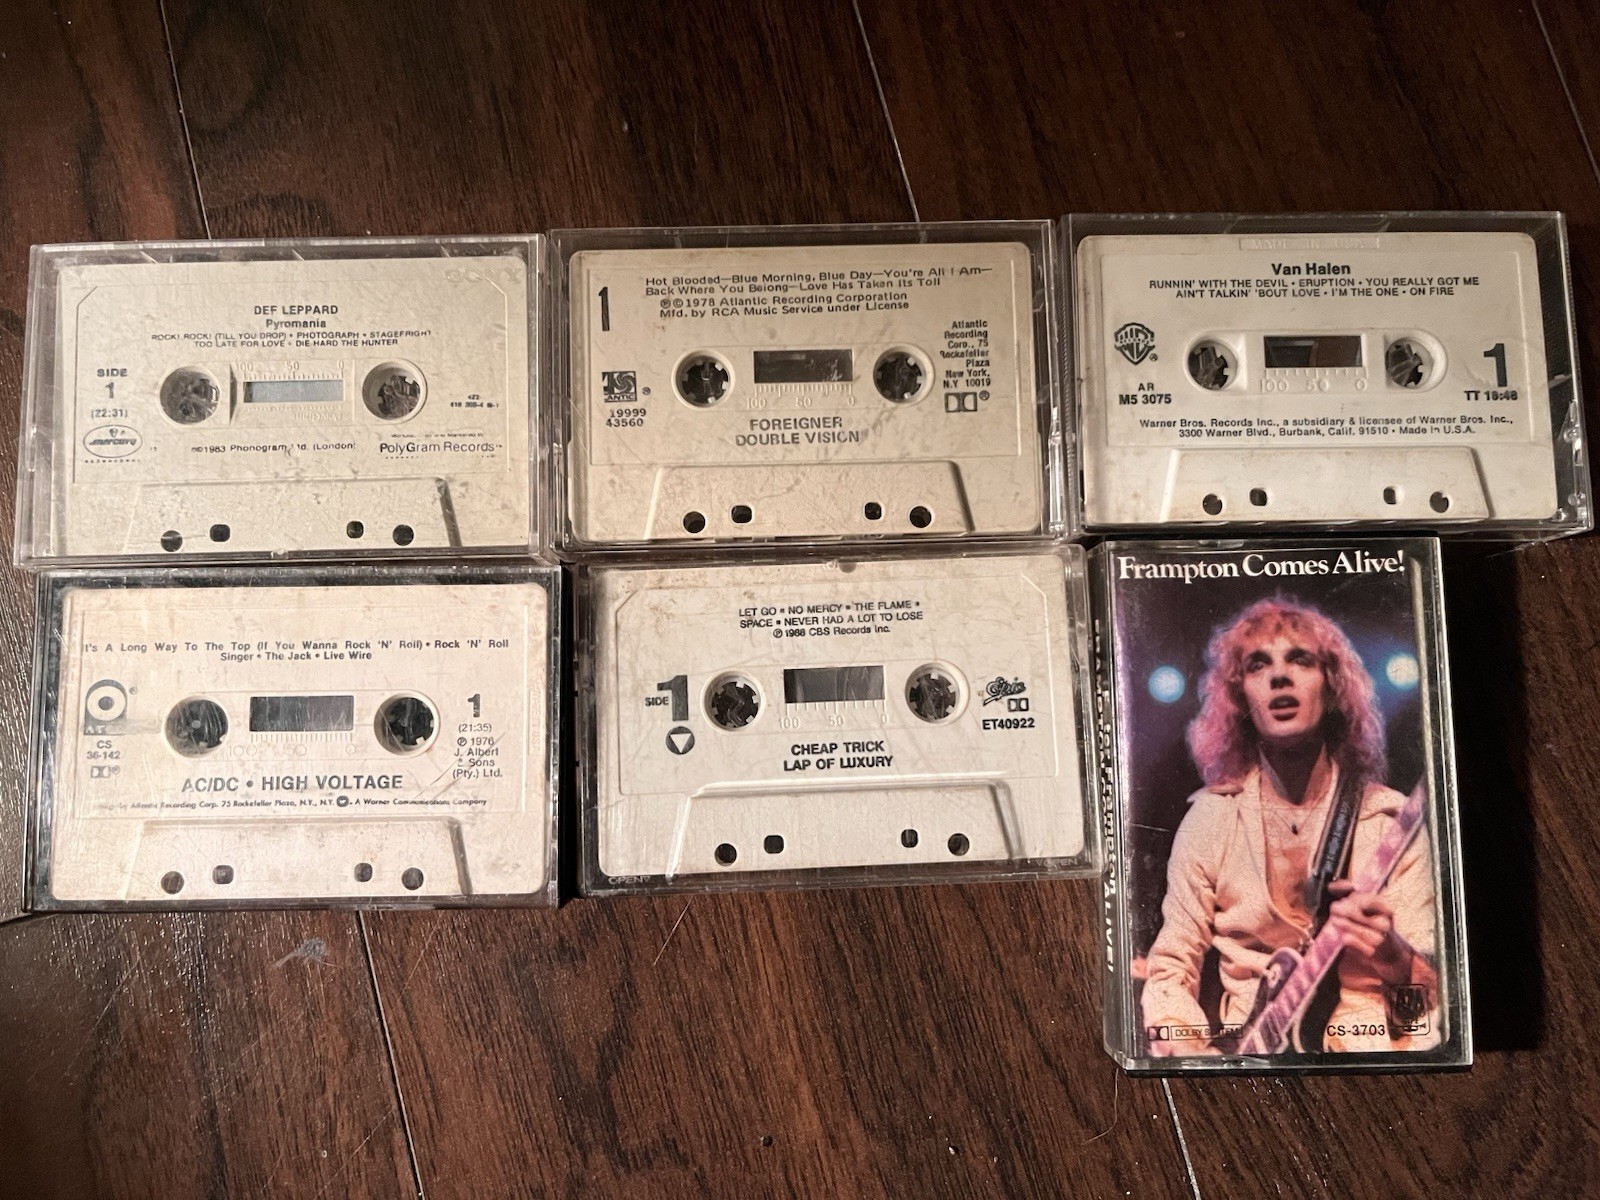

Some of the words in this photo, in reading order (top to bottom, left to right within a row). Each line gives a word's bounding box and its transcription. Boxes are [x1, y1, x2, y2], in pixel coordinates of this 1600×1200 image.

[1271, 263, 1301, 276] Van
[1306, 263, 1350, 275] Halen
[646, 277, 667, 286] Hot
[820, 272, 845, 281] Blue
[1149, 280, 1195, 289] RUNNIN'
[1199, 280, 1227, 288] WITH
[1230, 279, 1251, 288] THE
[1256, 279, 1288, 288] DEVIL
[1299, 279, 1355, 287] ERUPTION
[1365, 278, 1389, 286] YOU
[1393, 277, 1433, 286] REALLY
[1438, 277, 1460, 286] GOT
[1463, 277, 1479, 285] ME
[646, 286, 674, 296] Back
[679, 286, 715, 294] Where
[719, 284, 744, 293] You
[833, 281, 853, 290] Has
[858, 280, 893, 289] Taken
[899, 279, 913, 287] Its
[919, 278, 940, 287] Toll
[1176, 289, 1204, 298] AIN'T
[1209, 289, 1251, 298] TALKIN'
[1255, 288, 1289, 298] 'BOUT
[1293, 289, 1320, 297] LOVE
[1332, 288, 1348, 297] I'M
[1351, 288, 1372, 296] THE
[1376, 287, 1399, 296] ONE
[1410, 287, 1426, 296] ON
[1429, 287, 1454, 296] FIRE
[720, 297, 767, 307] Atlantic
[772, 295, 832, 304] Recording
[837, 292, 907, 303] Corporation
[254, 305, 277, 315] DEF
[282, 305, 339, 315] LEPPARD
[598, 286, 610, 331] 1
[660, 309, 688, 318] Mfd.
[691, 309, 706, 318] by
[712, 308, 739, 316] RCA
[744, 306, 777, 316] Music
[782, 305, 823, 314] Service
[828, 303, 860, 312] under
[866, 302, 909, 311] License
[266, 319, 327, 331] Pyromania
[952, 319, 988, 329] Atlantic
[944, 330, 988, 339] Recording
[978, 339, 988, 347] 75
[966, 359, 990, 368] Plaza
[1484, 343, 1507, 387] 1
[97, 369, 127, 377] SIDE
[946, 370, 964, 378] New
[967, 369, 990, 377] York,
[966, 378, 991, 387] 10019
[1138, 383, 1155, 392] AR
[105, 382, 115, 399] 1
[1463, 390, 1480, 401] TT
[1119, 394, 1138, 405] M5
[1142, 394, 1172, 404] 3075
[91, 408, 128, 418] (22:31)
[610, 408, 647, 418] 19999
[606, 418, 644, 428] 43560
[750, 416, 842, 431] FOREIGNER
[1139, 419, 1176, 428] Warner
[1180, 419, 1206, 428] Bros.
[1210, 419, 1253, 427] Records
[1257, 419, 1279, 427] Inc.,
[1292, 418, 1345, 426] subsidiary
[1359, 417, 1402, 425] licensee
[1406, 416, 1416, 424] of
[1420, 416, 1456, 424] Warner
[1460, 416, 1486, 424] Bros.
[1490, 415, 1513, 424] Inc.,
[1179, 429, 1202, 437] 3300
[1206, 429, 1242, 437] Warner
[1246, 428, 1275, 437] Blvd.,
[1279, 427, 1325, 437] Burbank,
[1328, 427, 1355, 436] Calif.
[1359, 427, 1389, 435] 91510
[1399, 426, 1427, 434] Made
[1444, 425, 1475, 434] U.S.A.
[736, 432, 799, 446] DOUBLE
[805, 431, 860, 444] VISION
[230, 444, 287, 453] Phonogram
[380, 442, 440, 455] PolyGram
[443, 441, 495, 452] Records
[1117, 556, 1240, 584] Frampton
[1242, 554, 1329, 577] Comes
[1332, 550, 1405, 574] Alive!
[739, 608, 757, 617] LET
[761, 607, 777, 616] GO
[788, 606, 803, 615] NO
[807, 604, 843, 614] MERCY
[854, 602, 874, 611] THE
[878, 601, 911, 610] FLAME
[740, 619, 773, 628] SPACE
[784, 617, 819, 627] NEVER
[822, 616, 843, 625] HAD
[847, 615, 854, 623] A
[857, 614, 876, 623] LOT
[880, 613, 893, 622] TO
[897, 611, 923, 621] LOSE
[809, 627, 830, 636] CBS
[834, 626, 871, 635] Records
[875, 625, 891, 633] Inc.
[106, 643, 113, 652] A
[121, 643, 147, 654] Long
[154, 642, 178, 653] Way
[185, 642, 198, 651] To
[205, 642, 224, 651] The
[231, 642, 250, 652] Top
[275, 641, 295, 650] You
[302, 641, 338, 650] Wanna
[345, 641, 370, 649] Rock
[435, 640, 460, 649] Rock
[488, 639, 509, 648] Roll
[221, 652, 253, 663] Singer
[265, 652, 284, 660] The
[288, 651, 312, 660] Jack
[324, 651, 344, 660] Live
[349, 651, 372, 660] Wire
[645, 696, 669, 706] SIDE
[657, 675, 689, 722] 1
[468, 693, 481, 718] 1
[458, 723, 492, 733] (21:35)
[982, 718, 1035, 730] ET40922
[96, 740, 112, 749] CS
[791, 742, 838, 755] CHEAP
[843, 740, 884, 753] TRICK
[87, 751, 120, 759] 36-142
[467, 747, 499, 757] Albert
[468, 758, 495, 767] Sons
[783, 759, 811, 772] LAP
[815, 758, 835, 770] OF
[840, 756, 893, 768] LUXURY
[483, 768, 503, 778] Ltd.
[181, 777, 239, 793] AC/DC
[262, 776, 308, 791] HIGH
[316, 775, 403, 790] VOLTAGE
[1326, 1024, 1386, 1037] CS-3703
